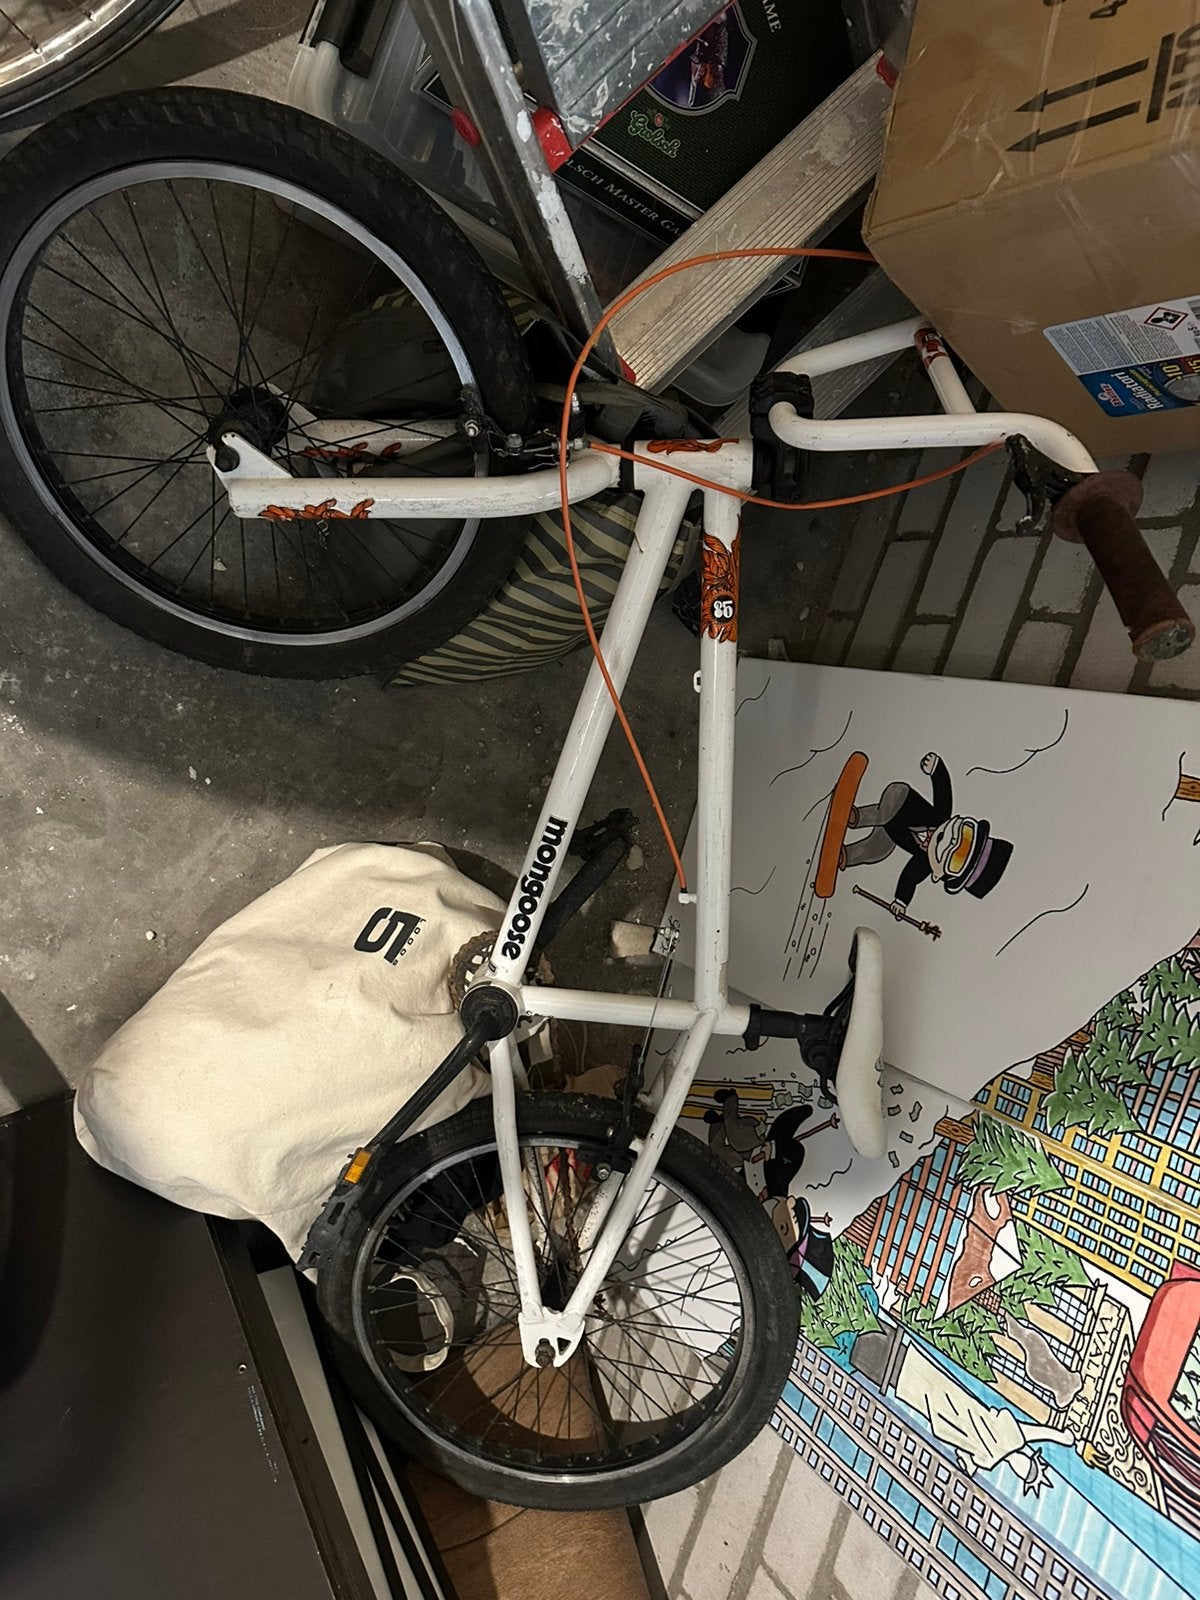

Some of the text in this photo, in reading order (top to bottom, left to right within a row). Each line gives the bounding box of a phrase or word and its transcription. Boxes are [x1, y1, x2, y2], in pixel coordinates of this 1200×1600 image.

[628, 110, 681, 159] Grolsch
[604, 182, 659, 221] MASTER
[660, 219, 682, 236] GA
[1110, 371, 1164, 410] Radiatori
[501, 815, 568, 960] mongoose
[1083, 1316, 1113, 1384] WALL
